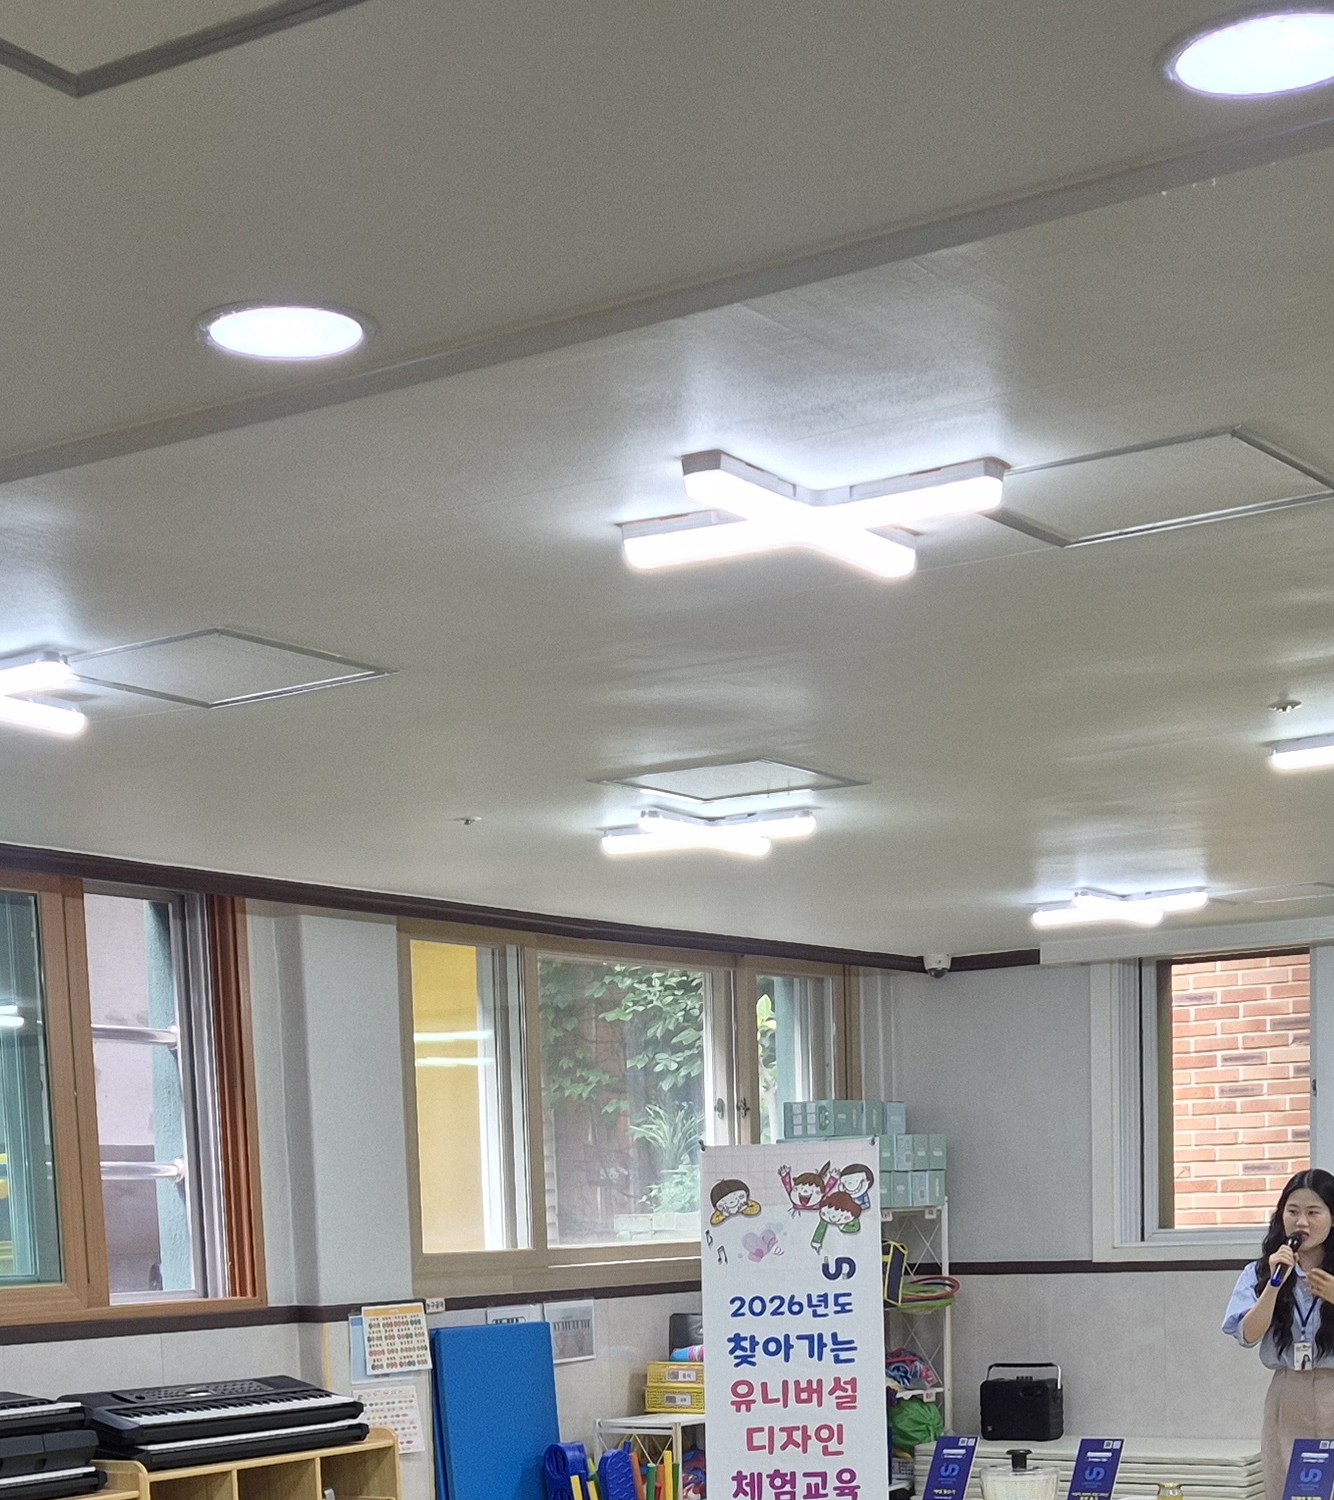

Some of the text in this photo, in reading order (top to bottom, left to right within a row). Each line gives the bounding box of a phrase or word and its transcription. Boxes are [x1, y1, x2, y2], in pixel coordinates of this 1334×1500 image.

[729, 1292, 854, 1318] 2026년도
[727, 1331, 858, 1368] 찾아가는
[730, 1376, 858, 1413] 유니버설
[746, 1423, 845, 1457] 디자인
